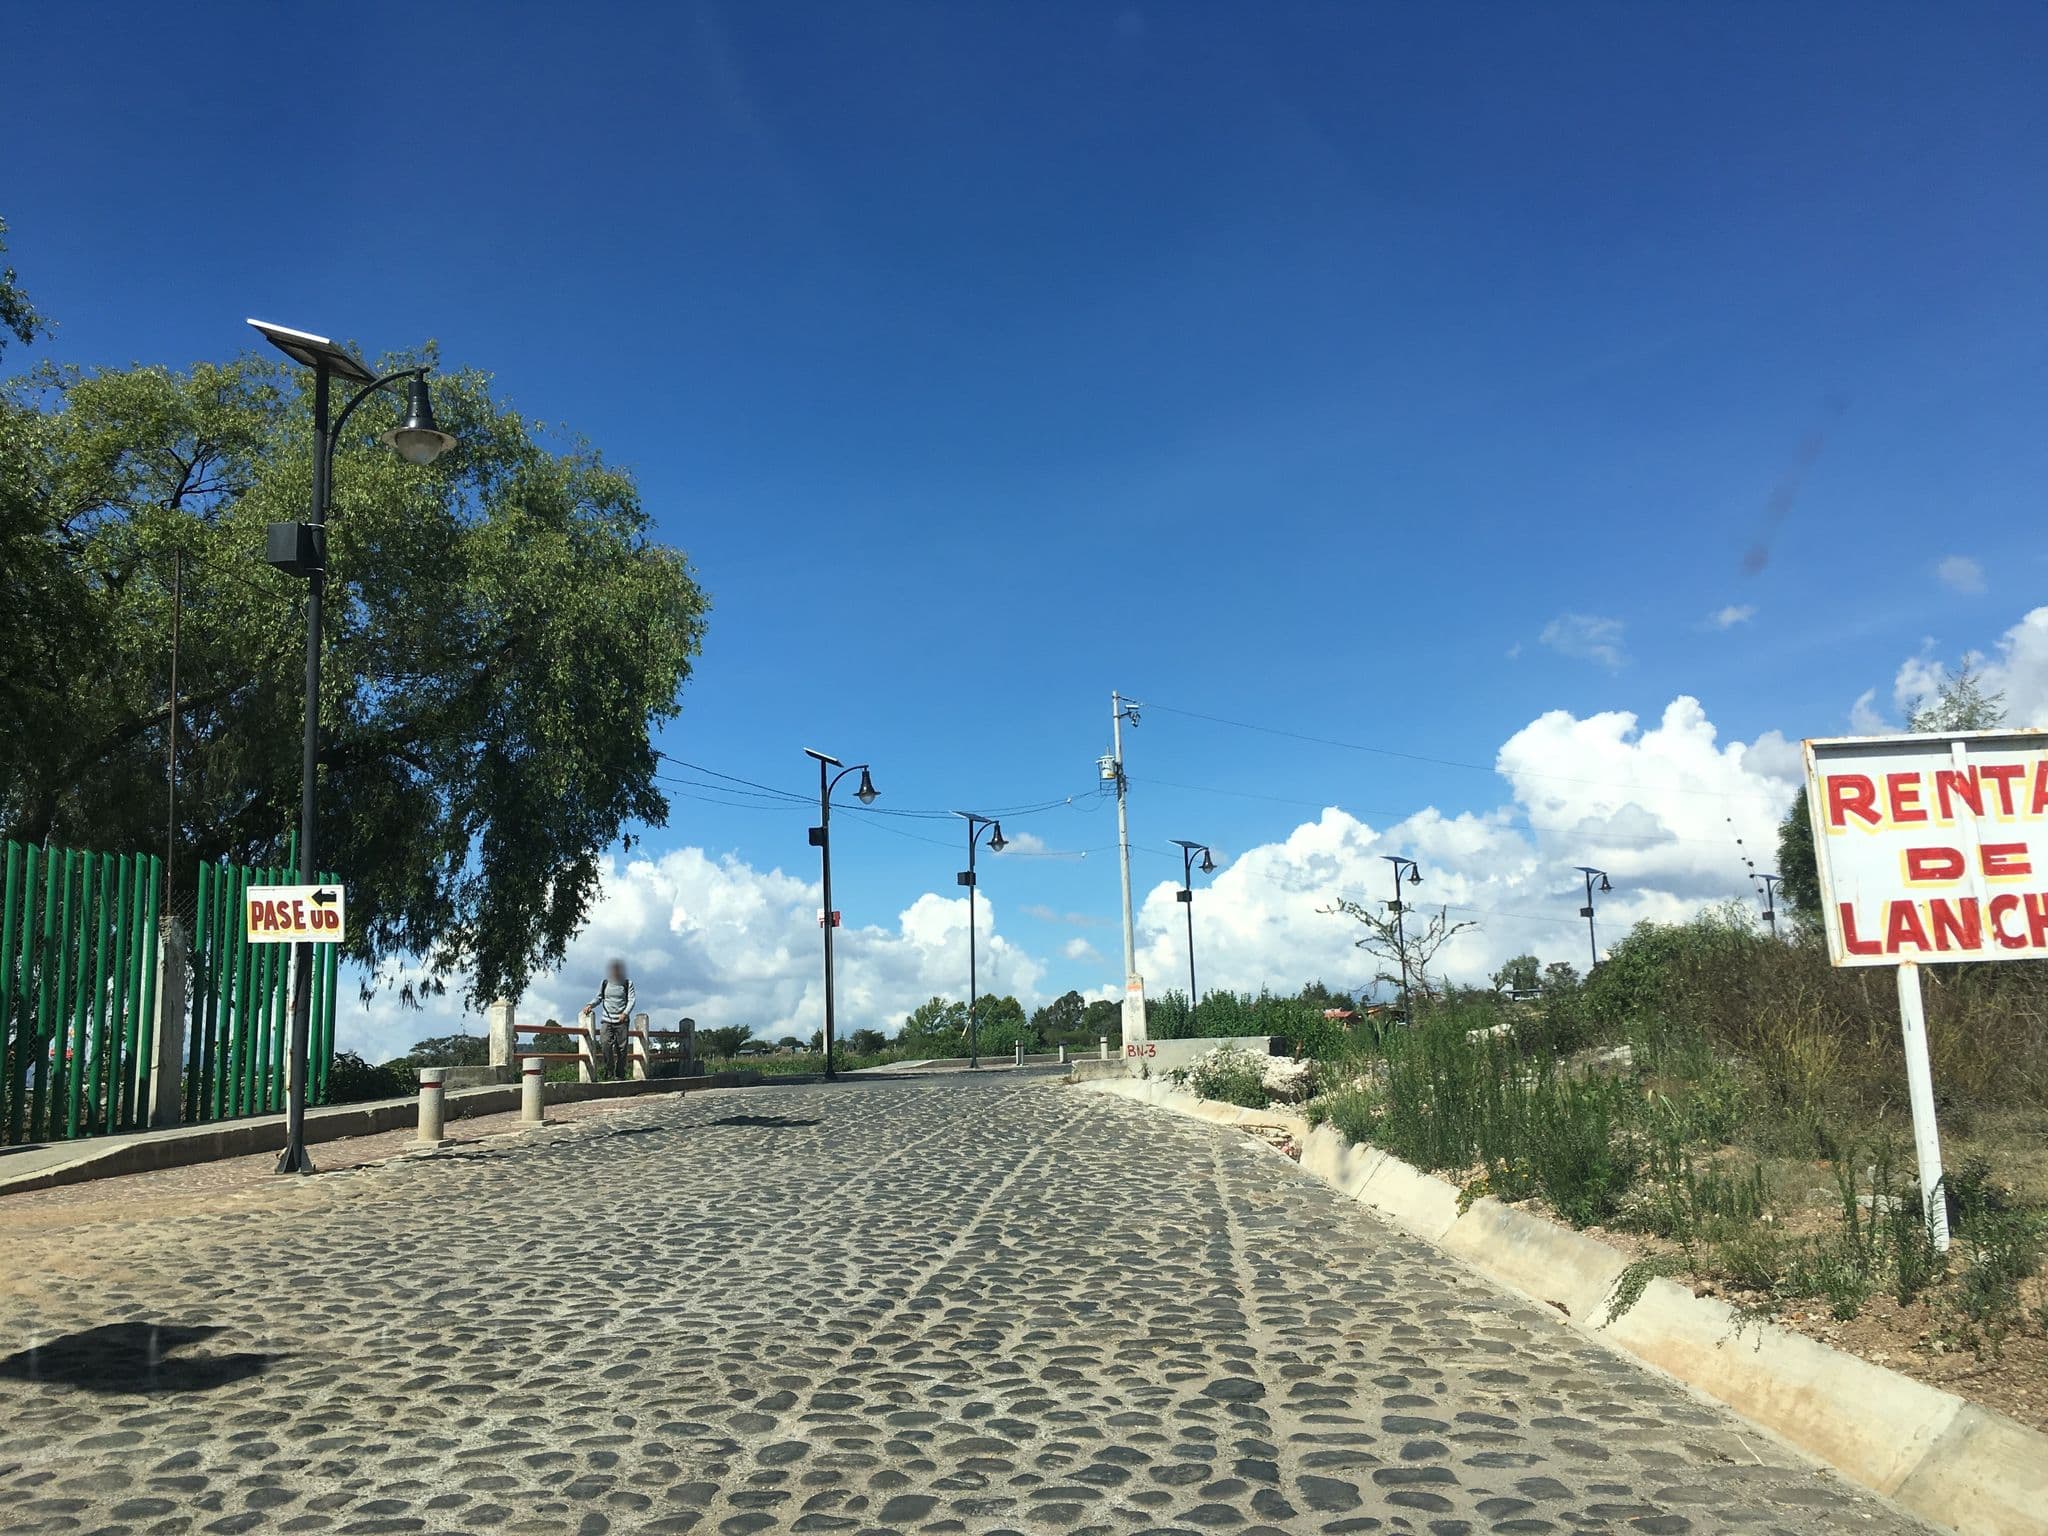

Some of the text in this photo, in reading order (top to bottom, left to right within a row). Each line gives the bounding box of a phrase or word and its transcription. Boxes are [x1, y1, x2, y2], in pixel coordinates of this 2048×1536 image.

[1906, 842, 2033, 881] DE
[251, 899, 340, 931] PASE UD
[1839, 892, 2048, 955] LANCH
